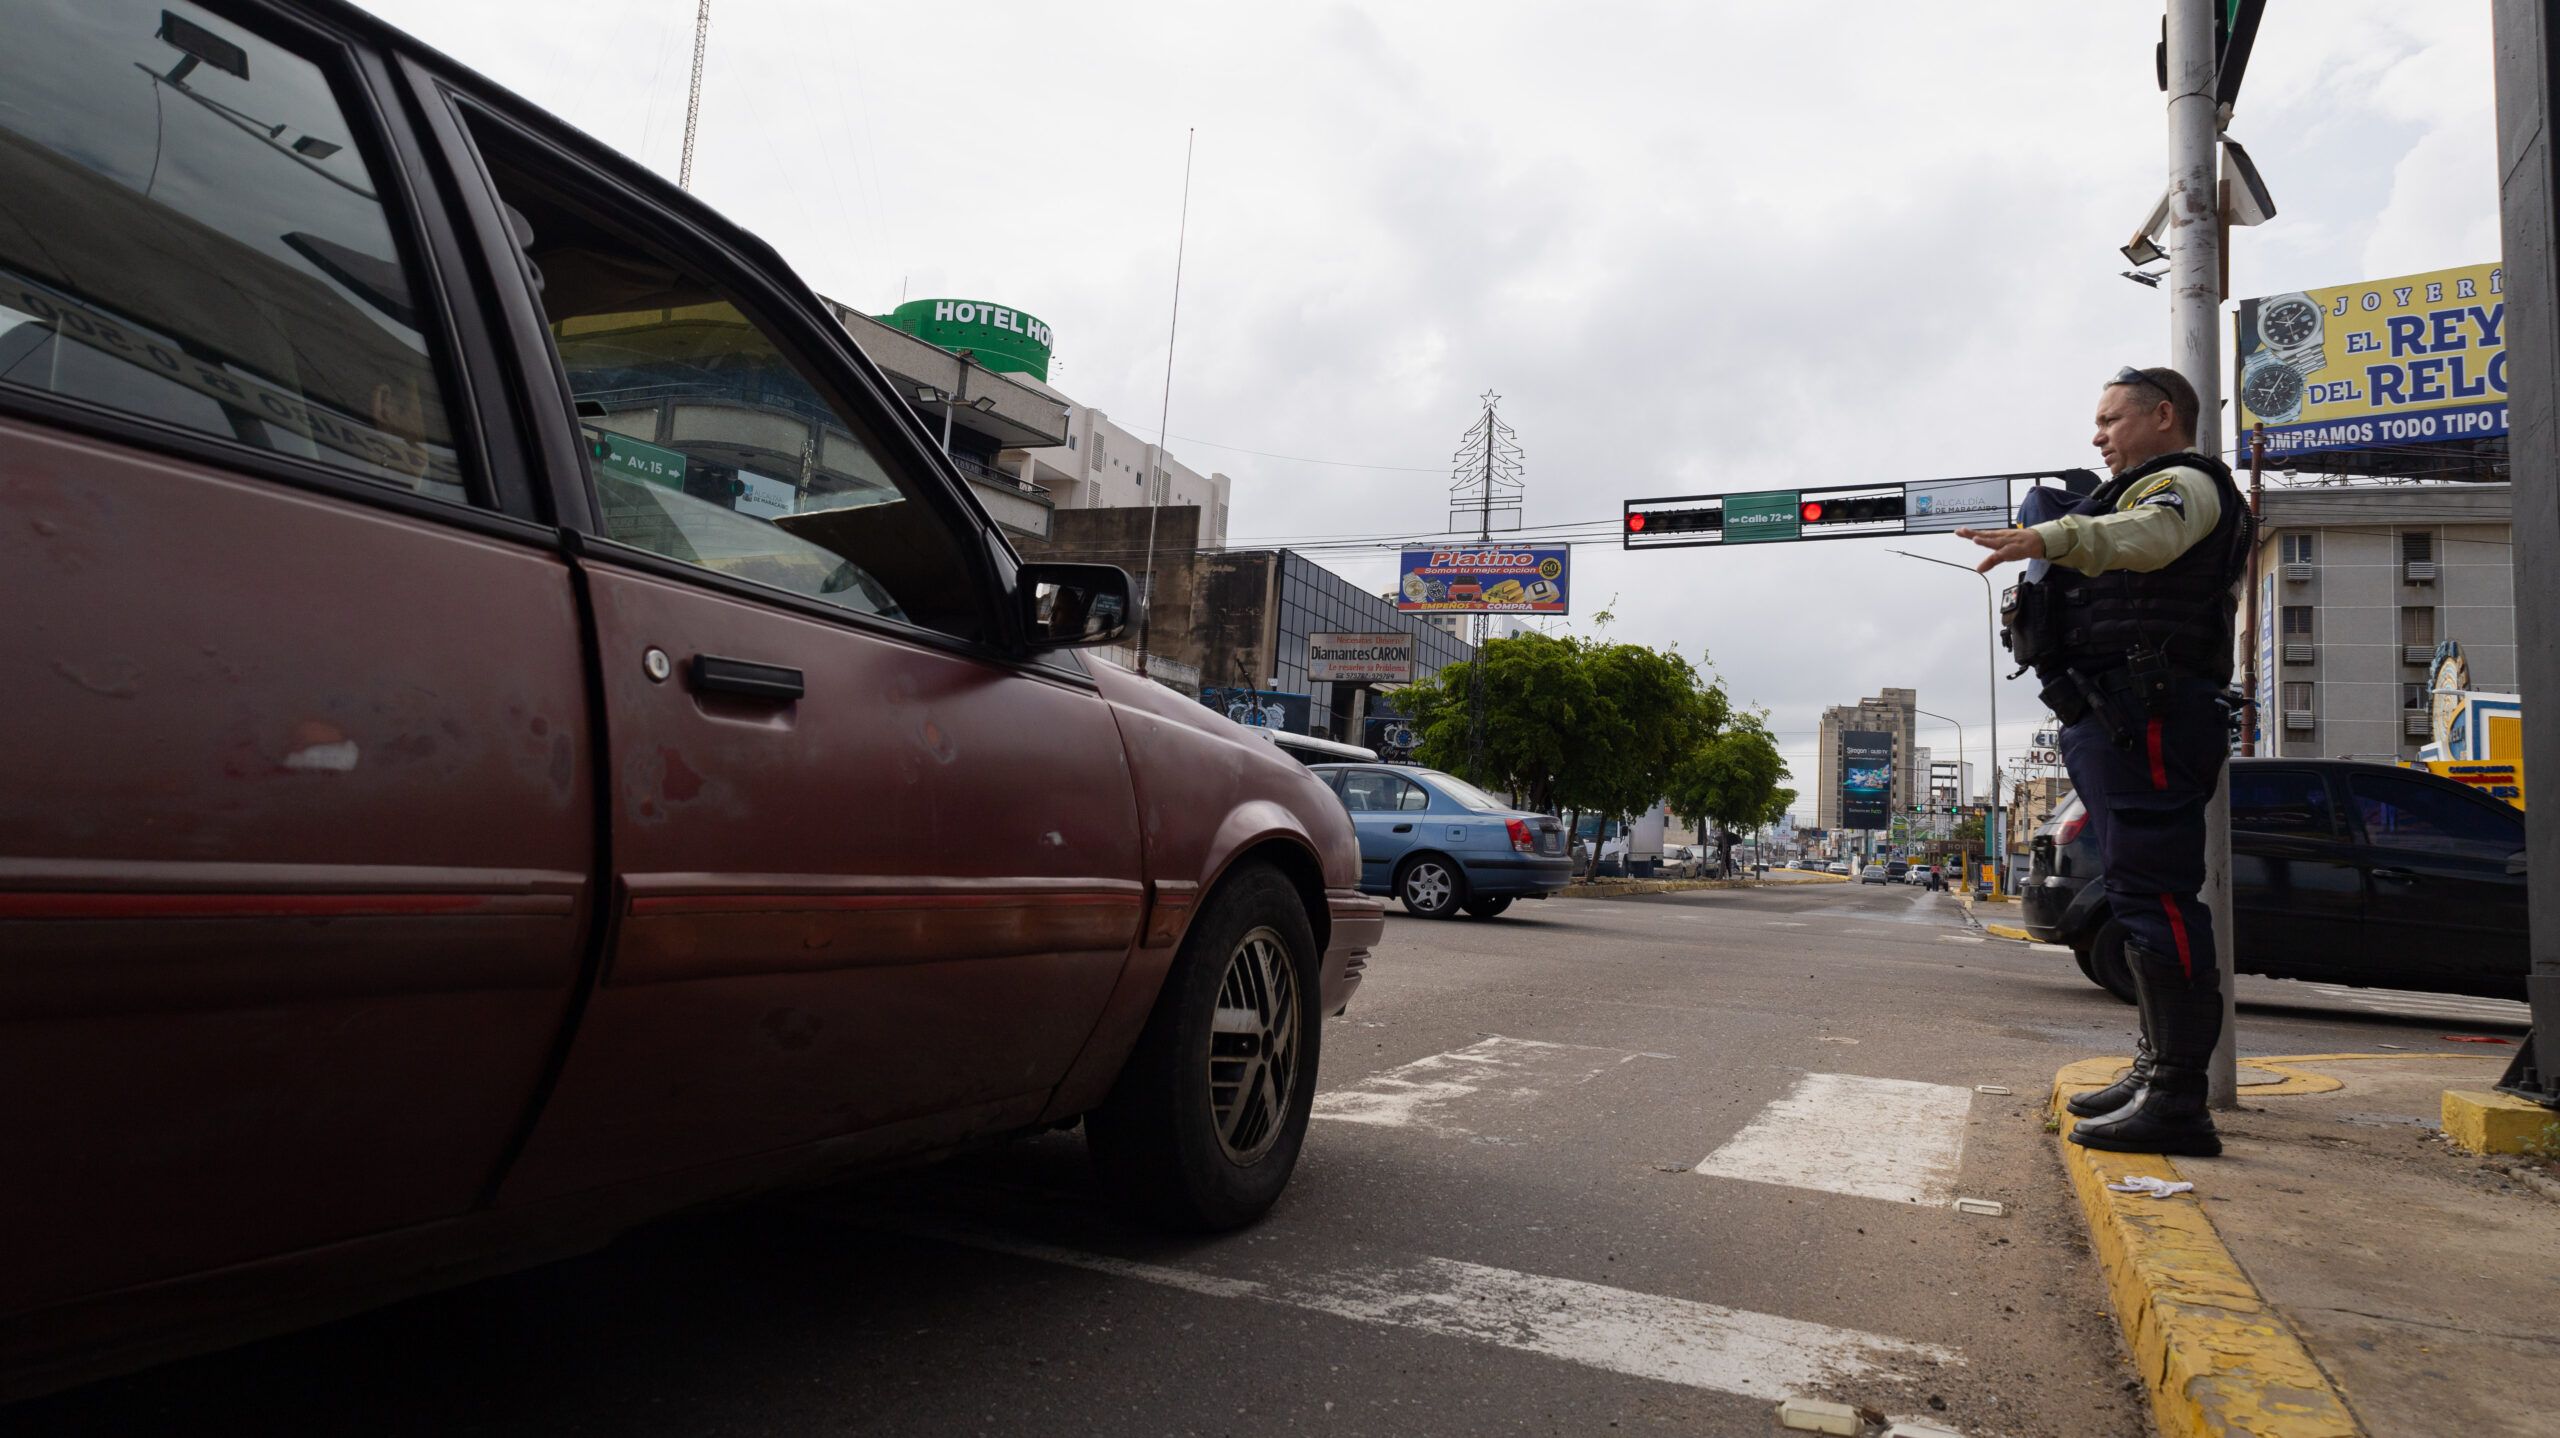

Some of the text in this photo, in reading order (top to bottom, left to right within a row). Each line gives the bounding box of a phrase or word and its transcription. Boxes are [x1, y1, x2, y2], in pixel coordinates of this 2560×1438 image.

[935, 301, 1024, 335] HOTEL
[2346, 303, 2505, 358] EL REY
[2308, 380, 2362, 406] DEL
[2251, 424, 2374, 452] OMPRAMOS
[2379, 416, 2437, 442] TODO
[2443, 411, 2494, 434] TIPO
[628, 456, 663, 475] Av. 15
[1936, 496, 1986, 507] ALCALDÍA
[1741, 513, 1782, 524] Calle 72
[1431, 552, 1534, 567] Platino
[1473, 567, 1501, 575] mejor
[1311, 646, 1410, 661] Diamantes CARONI
